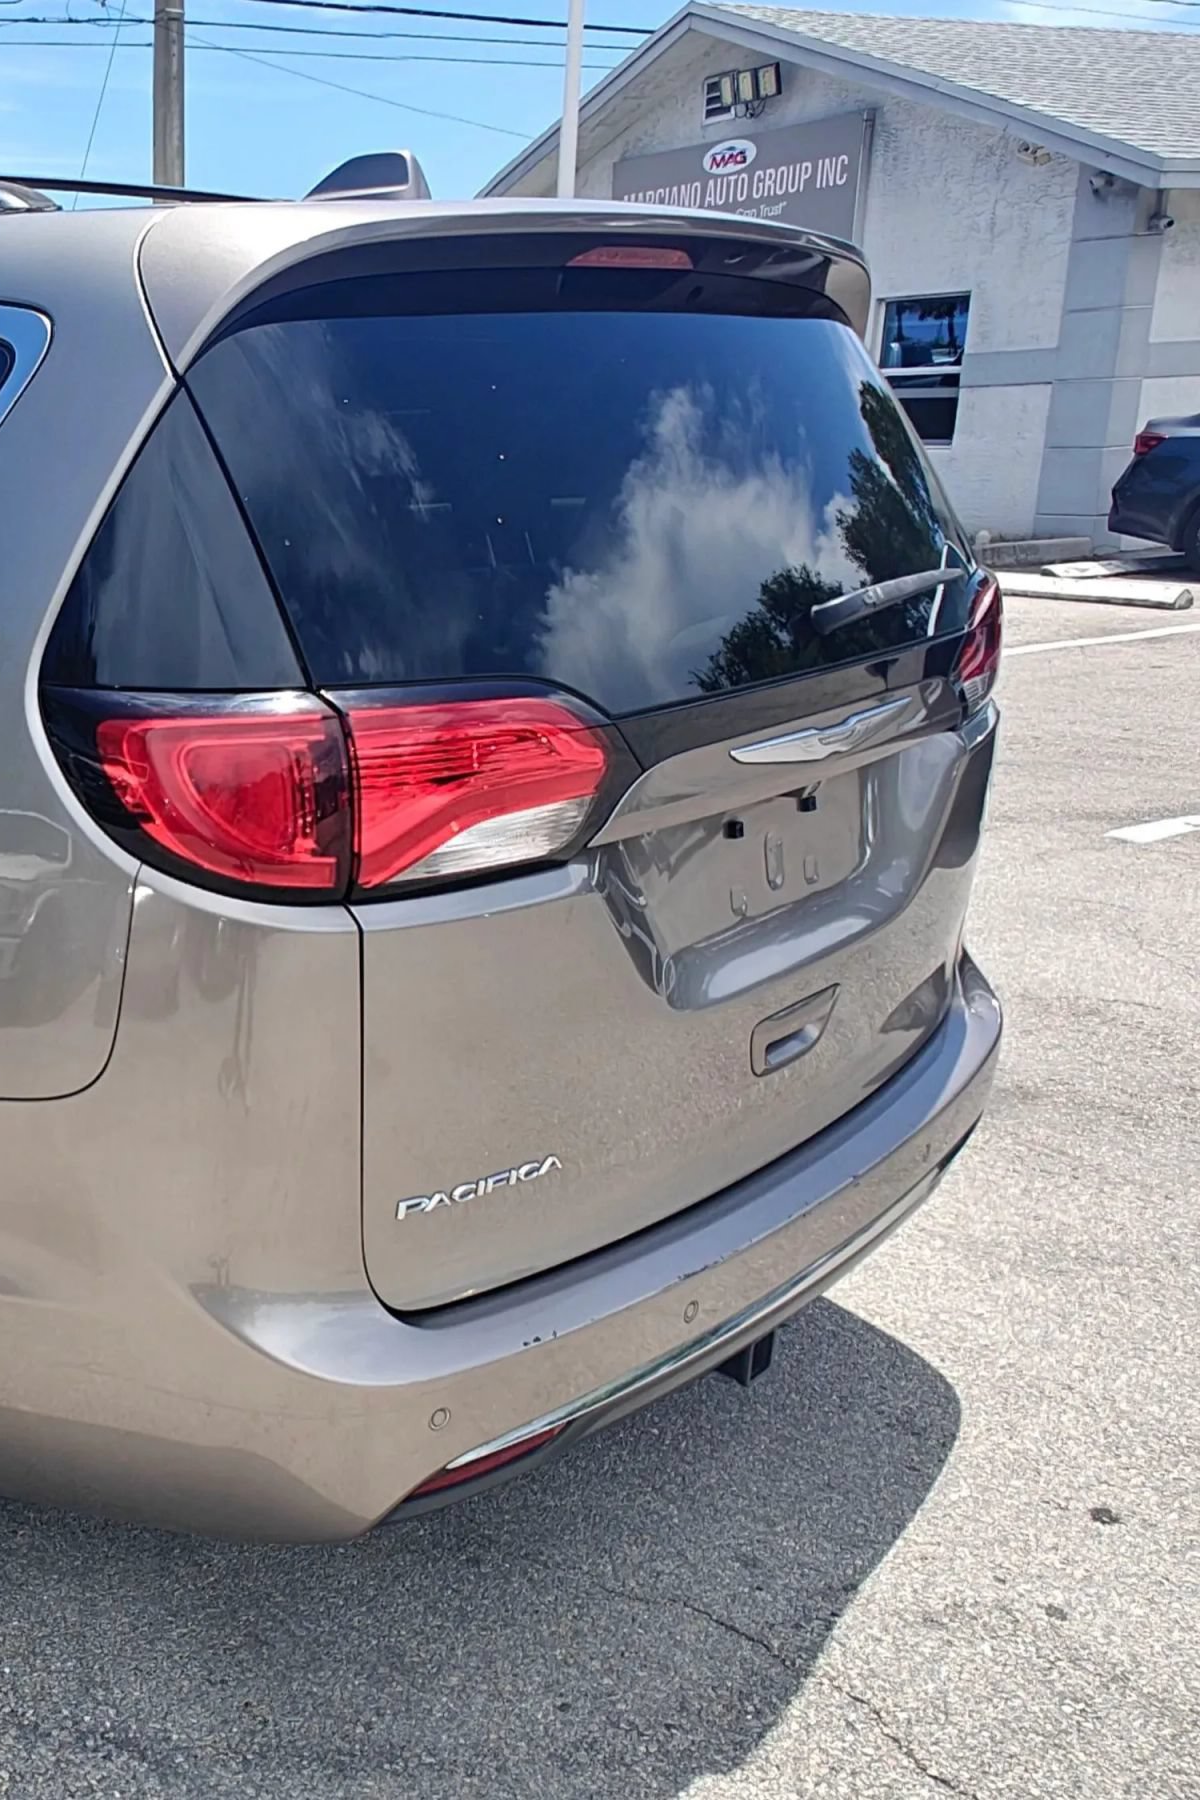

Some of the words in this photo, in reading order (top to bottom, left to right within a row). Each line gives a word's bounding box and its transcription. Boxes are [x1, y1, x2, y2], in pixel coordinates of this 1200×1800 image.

[623, 181, 701, 209] RCIANO
[704, 173, 748, 208] AUTO
[752, 162, 812, 199] GROUP
[816, 155, 849, 188] INC
[709, 149, 747, 171] MAG
[395, 1154, 563, 1220] PACIFICA
